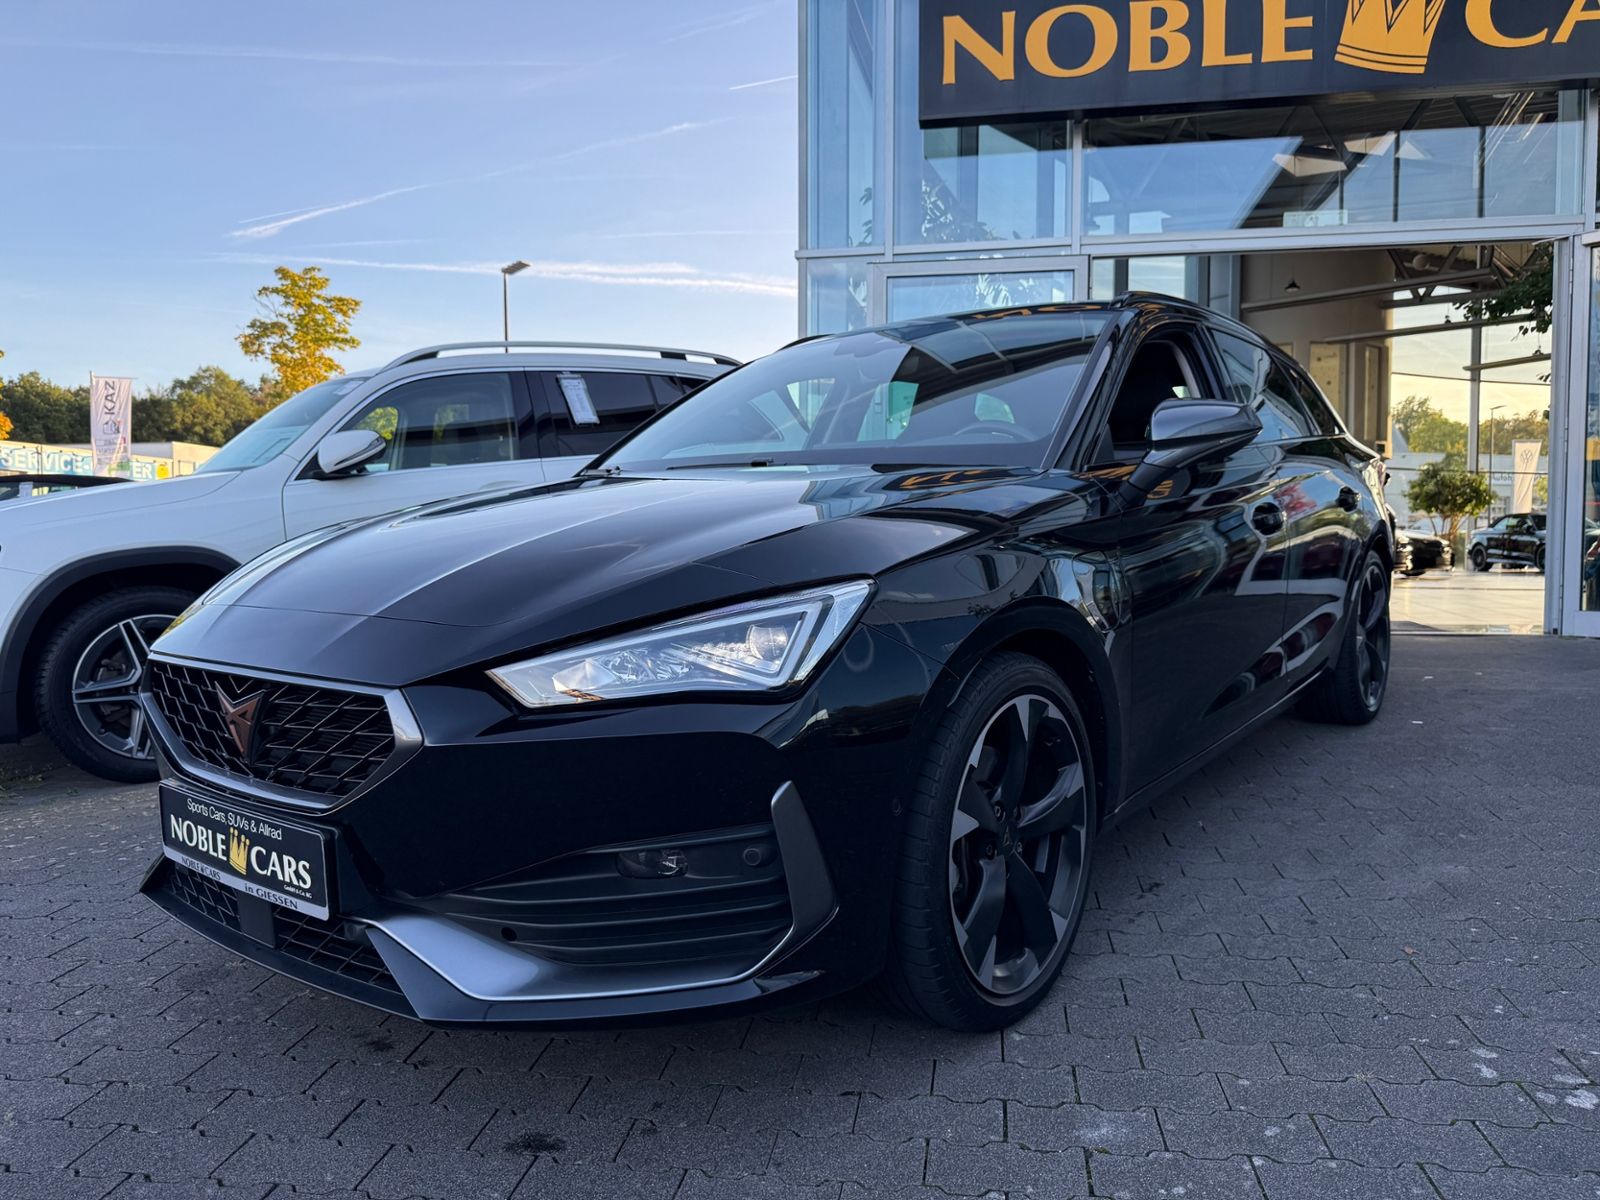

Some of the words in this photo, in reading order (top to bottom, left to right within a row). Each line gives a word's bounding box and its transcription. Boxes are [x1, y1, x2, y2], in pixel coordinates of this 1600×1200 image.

[942, 0, 1313, 85] NOBLE
[1465, 0, 1600, 48] C
[187, 798, 208, 816] Sports
[208, 806, 227, 824] Cars,
[227, 812, 249, 831] SUVs
[250, 820, 257, 833] &
[258, 822, 282, 840] Allrad
[170, 814, 227, 861] NOBLE
[250, 845, 312, 889] CARS
[181, 856, 200, 872] NOBLE
[205, 866, 221, 881] CARS
[244, 882, 254, 894] in
[256, 887, 298, 910] GIESSEN
